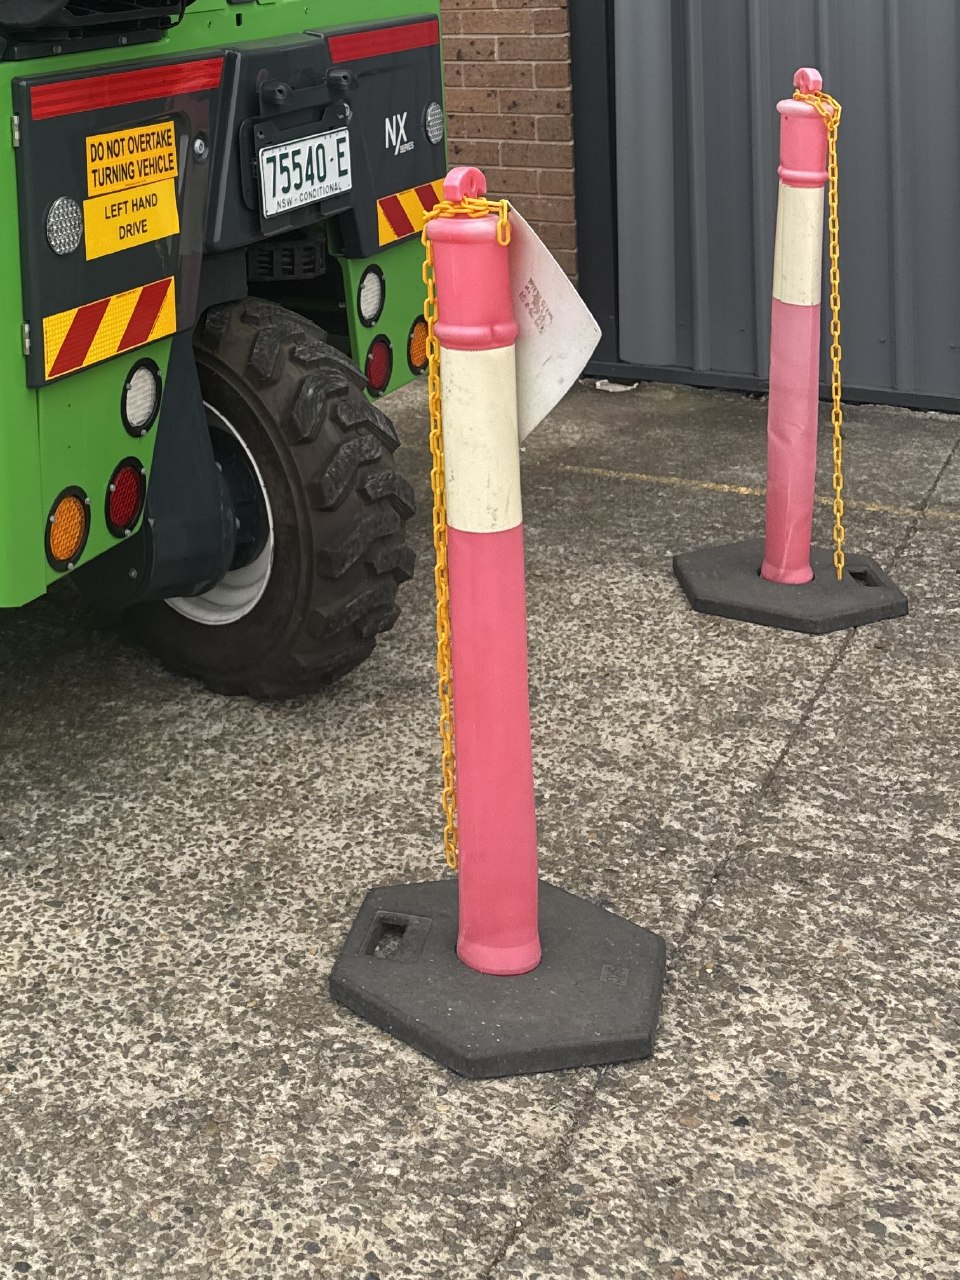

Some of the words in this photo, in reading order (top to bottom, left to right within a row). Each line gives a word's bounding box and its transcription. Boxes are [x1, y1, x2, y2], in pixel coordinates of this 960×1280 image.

[90, 142, 104, 162] DO
[107, 138, 125, 159] NOT
[127, 129, 172, 154] OVERTAKE
[385, 111, 407, 155] NX
[91, 161, 134, 188] TURNING
[137, 153, 174, 177] VEHICLE
[105, 201, 128, 219] LEFT
[132, 193, 158, 214] HAND
[277, 198, 292, 210] NSW
[300, 181, 341, 202] CONDITIONAL
[119, 219, 147, 239] DRIVE
